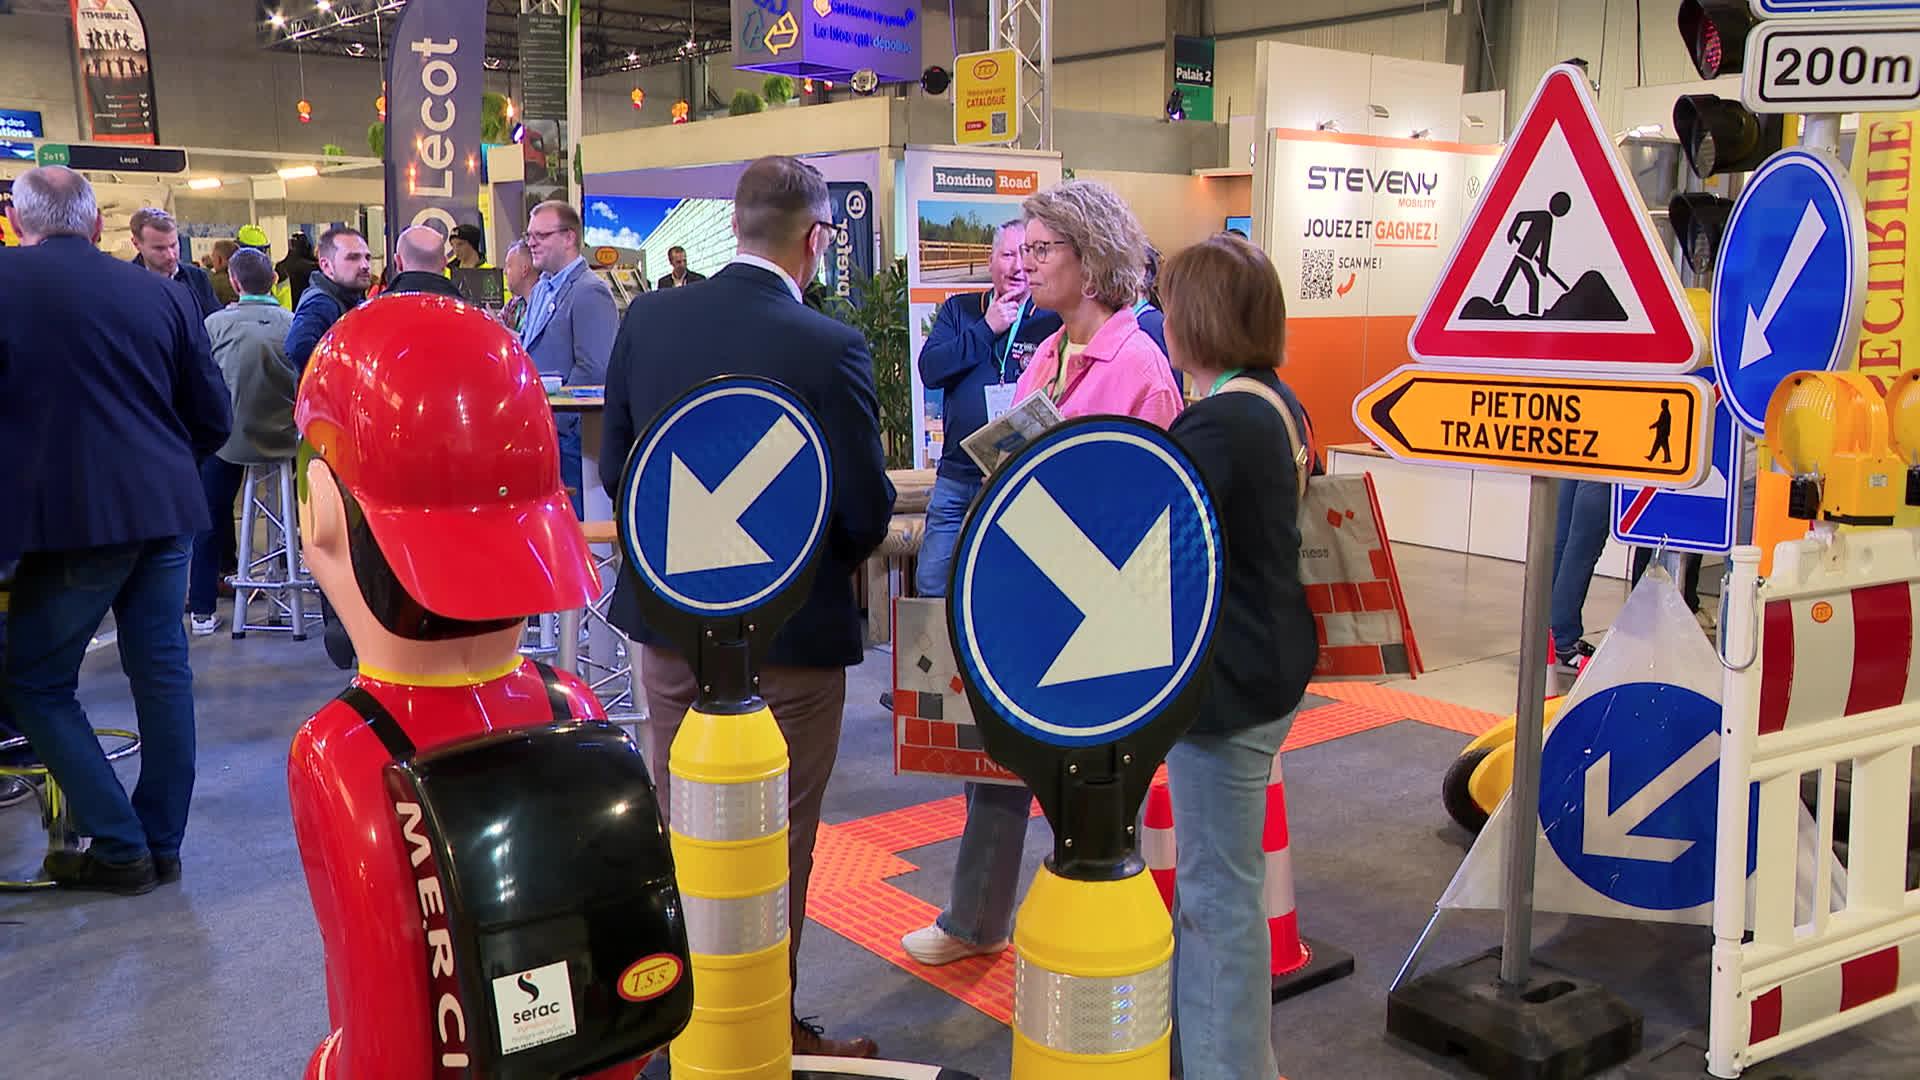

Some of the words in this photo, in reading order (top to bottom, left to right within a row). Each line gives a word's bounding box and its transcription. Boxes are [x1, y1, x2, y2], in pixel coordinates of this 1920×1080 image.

[1176, 67, 1203, 82] Palais
[1205, 70, 1212, 82] 2
[1774, 46, 1912, 86] 200m
[409, 38, 458, 198] Lecot
[935, 172, 993, 188] Rondino
[1307, 165, 1438, 195] STEVENY
[1398, 198, 1436, 209] MOBILITY
[1303, 218, 1353, 239] JOUEZ
[1355, 221, 1372, 238] ET
[1375, 220, 1432, 241] GAGNEZ
[1338, 257, 1362, 269] SCAN
[1470, 390, 1581, 423] PIETONS
[1440, 420, 1599, 458] TRAVERSEZ
[395, 801, 470, 1068] MERCI
[513, 1001, 560, 1024] serac
